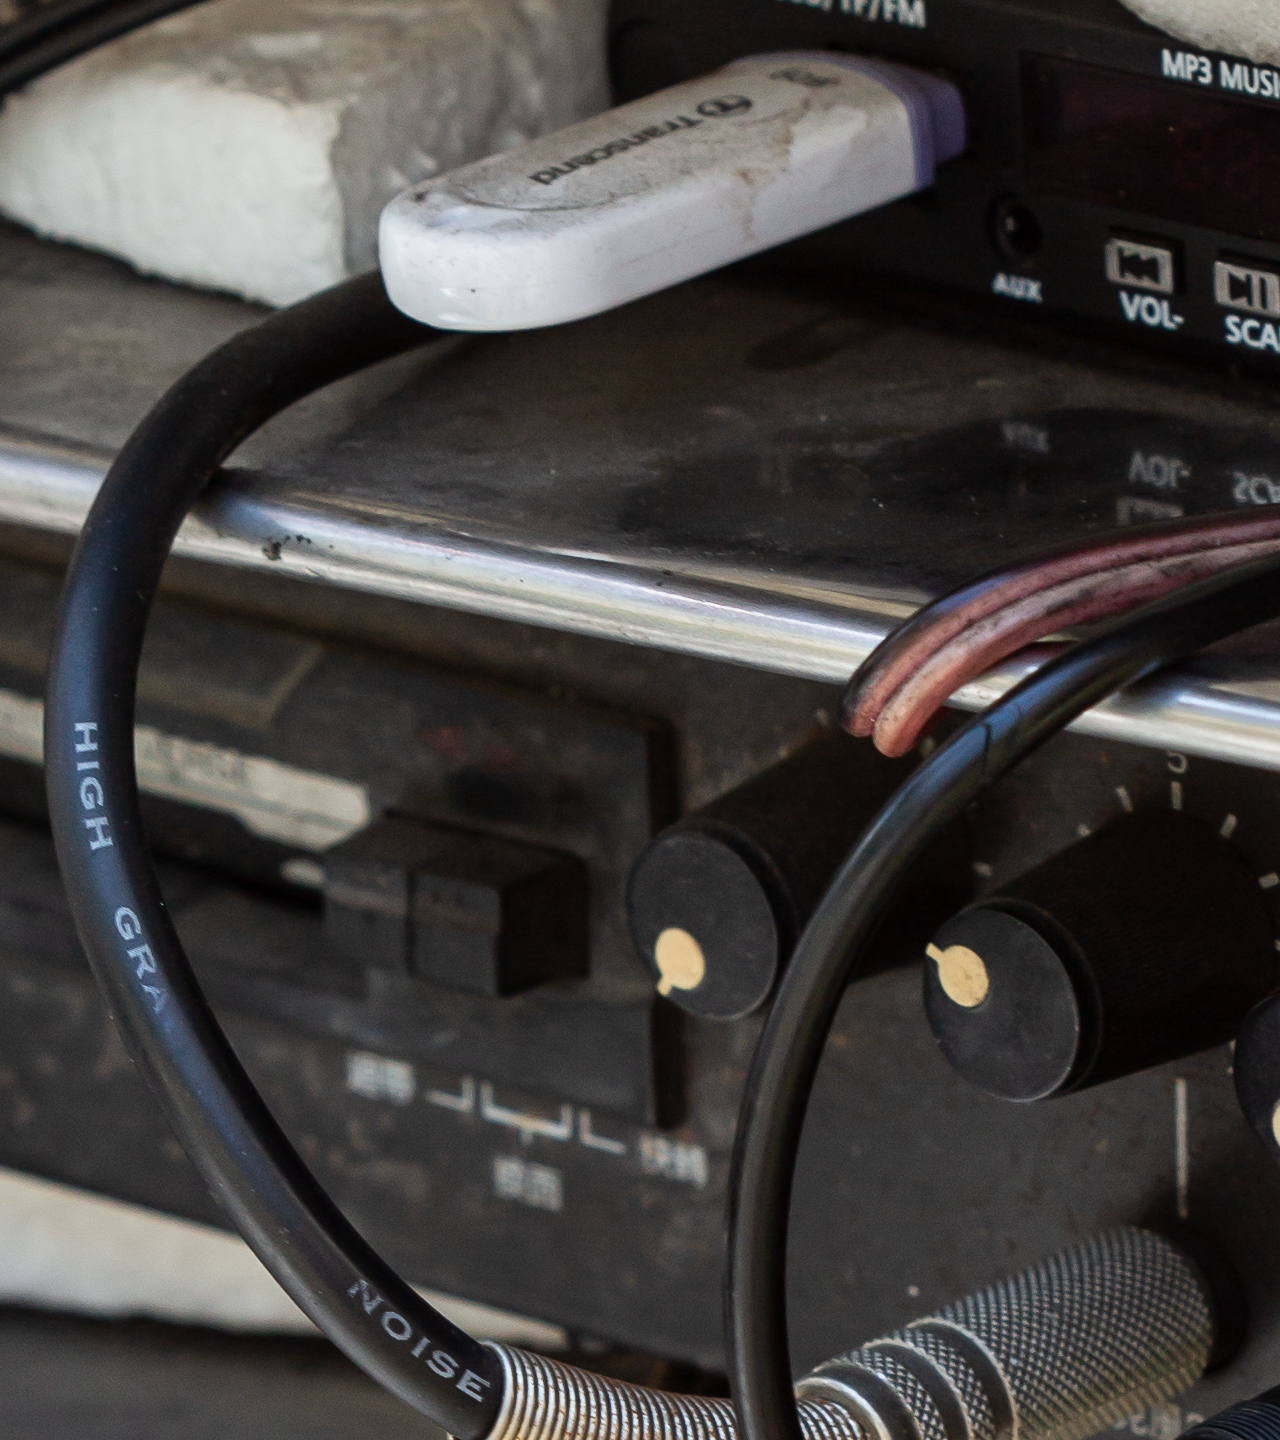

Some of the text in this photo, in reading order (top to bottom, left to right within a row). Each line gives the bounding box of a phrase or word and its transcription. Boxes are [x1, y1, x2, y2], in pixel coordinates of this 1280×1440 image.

[1160, 48, 1213, 85] MP3
[528, 114, 705, 187] Transcend
[991, 272, 1043, 303] AUX
[1119, 290, 1184, 330] VOL-
[74, 721, 114, 851] HIGH
[347, 1279, 491, 1403] NOISE
